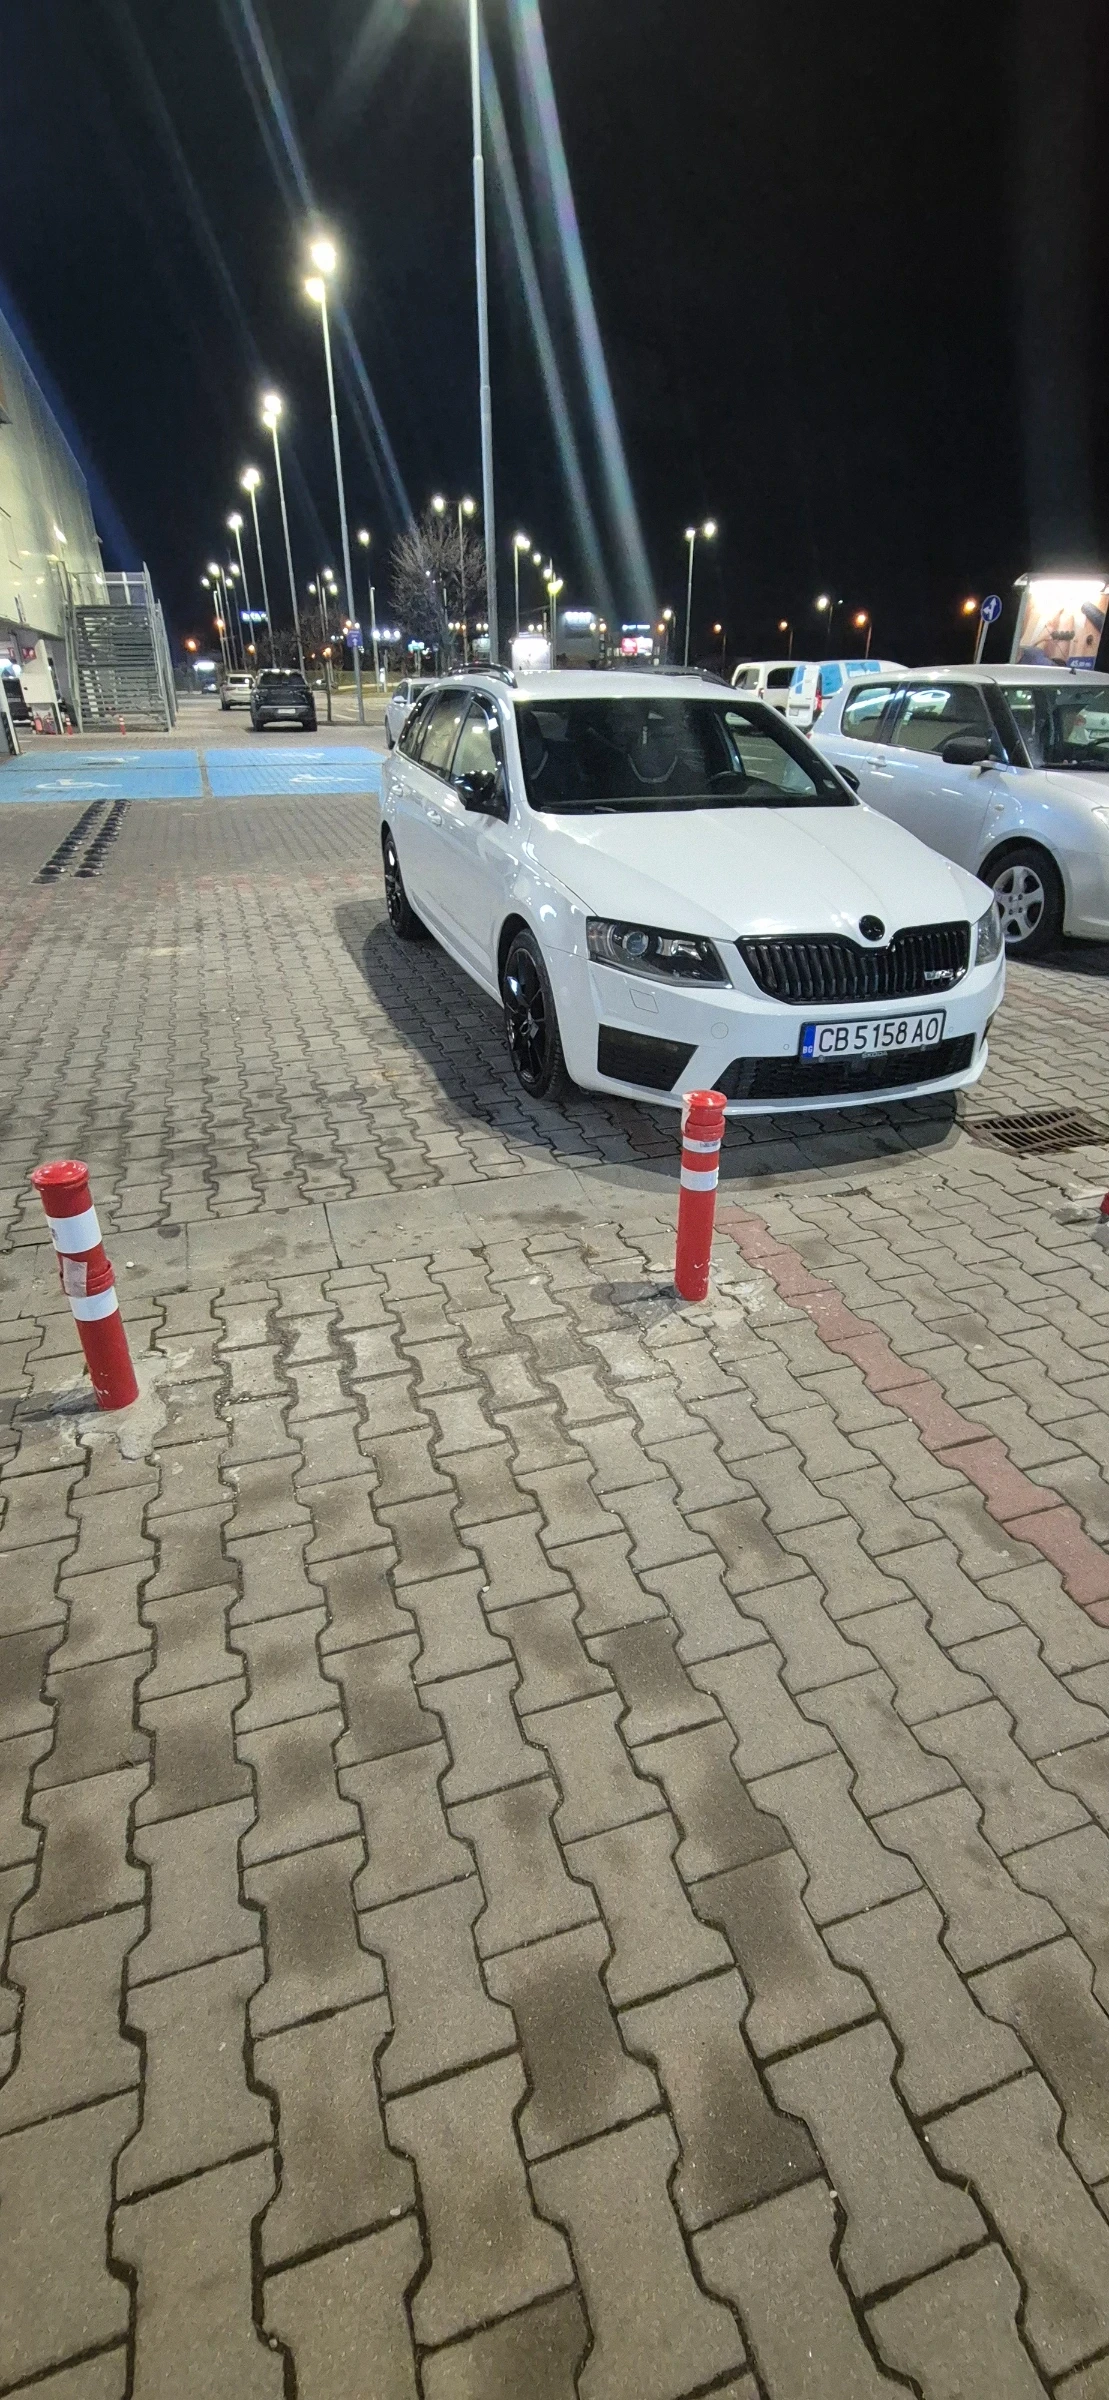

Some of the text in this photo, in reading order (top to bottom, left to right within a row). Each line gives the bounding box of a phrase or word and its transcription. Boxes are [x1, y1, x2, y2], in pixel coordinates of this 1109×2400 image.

[819, 1017, 939, 1053] CB 5158 AO
[802, 1045, 813, 1054] BG
